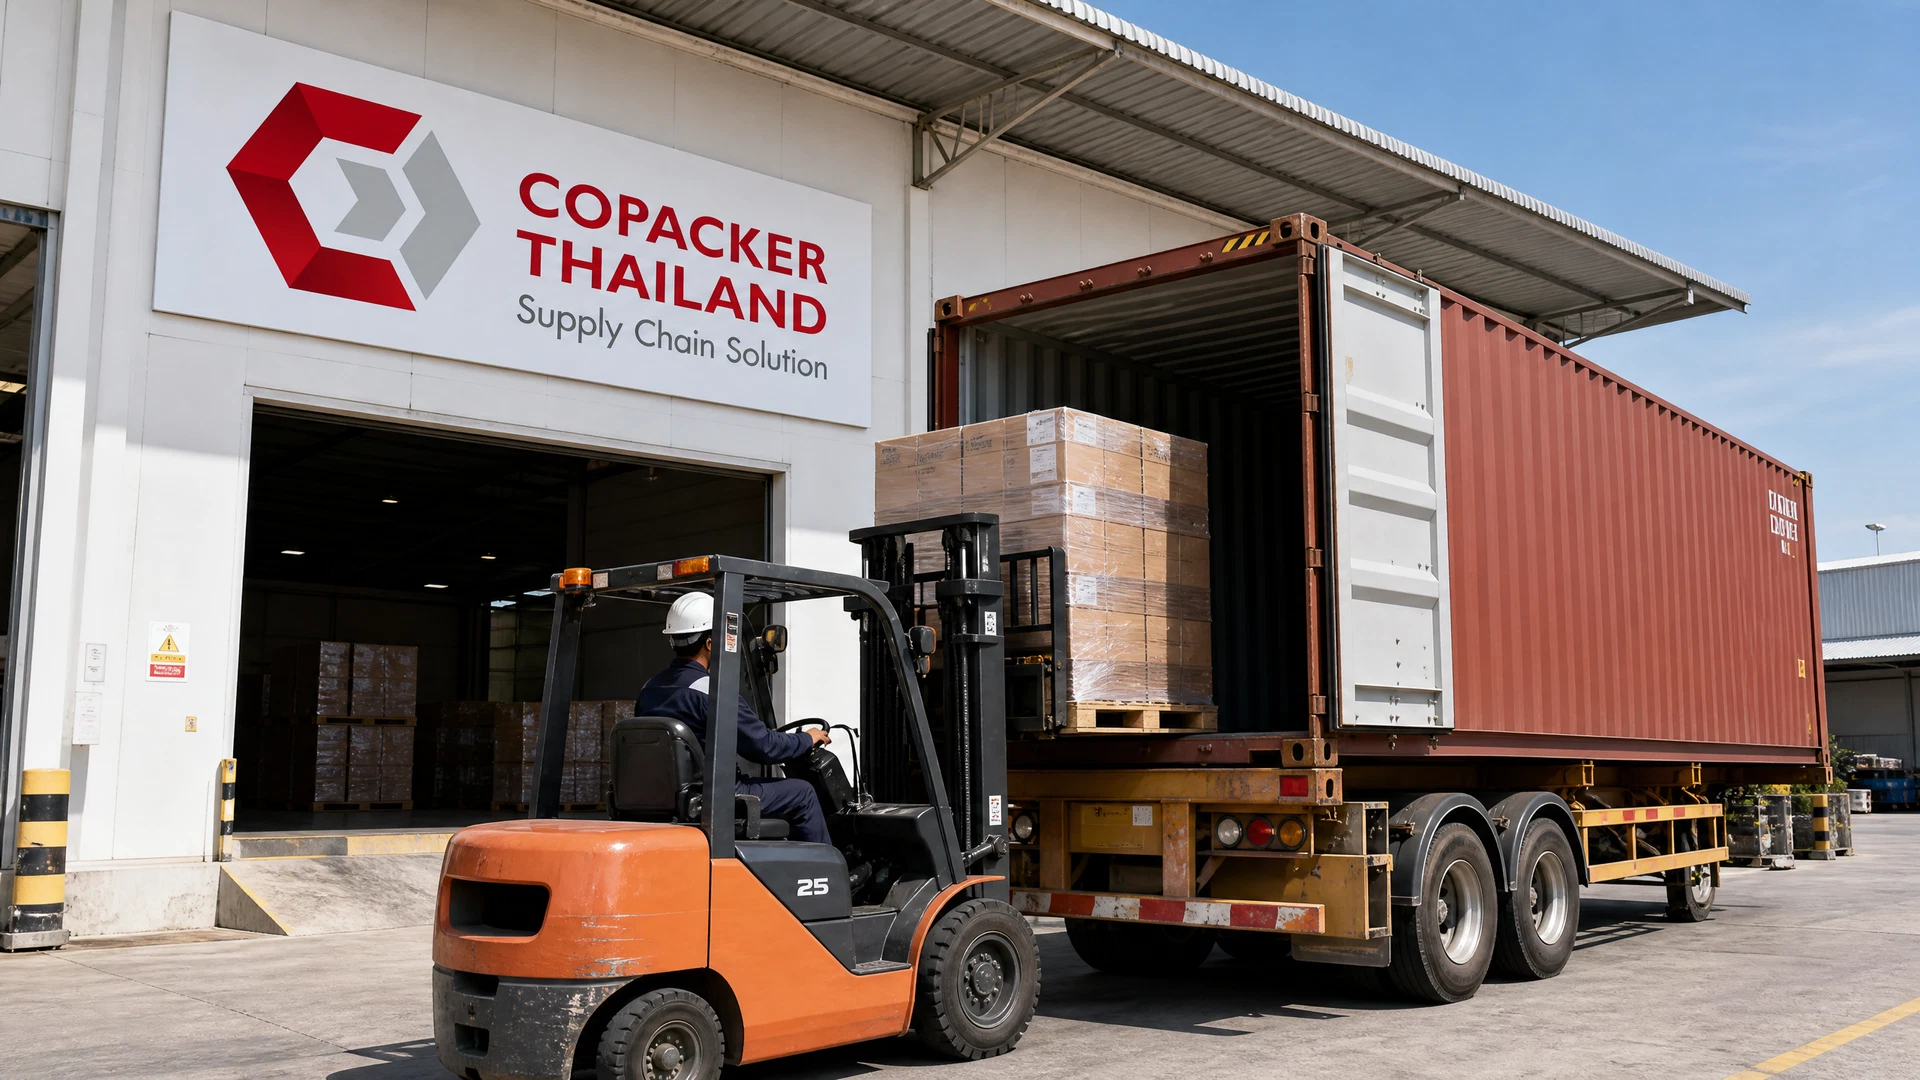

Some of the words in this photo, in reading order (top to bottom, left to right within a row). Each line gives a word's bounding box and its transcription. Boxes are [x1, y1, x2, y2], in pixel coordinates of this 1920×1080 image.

[519, 172, 827, 284] COPACKER
[517, 229, 827, 335] THAILAND
[516, 294, 623, 349] Supply
[634, 319, 715, 359] Chain
[726, 336, 828, 381] Solution
[797, 877, 829, 897] 25
